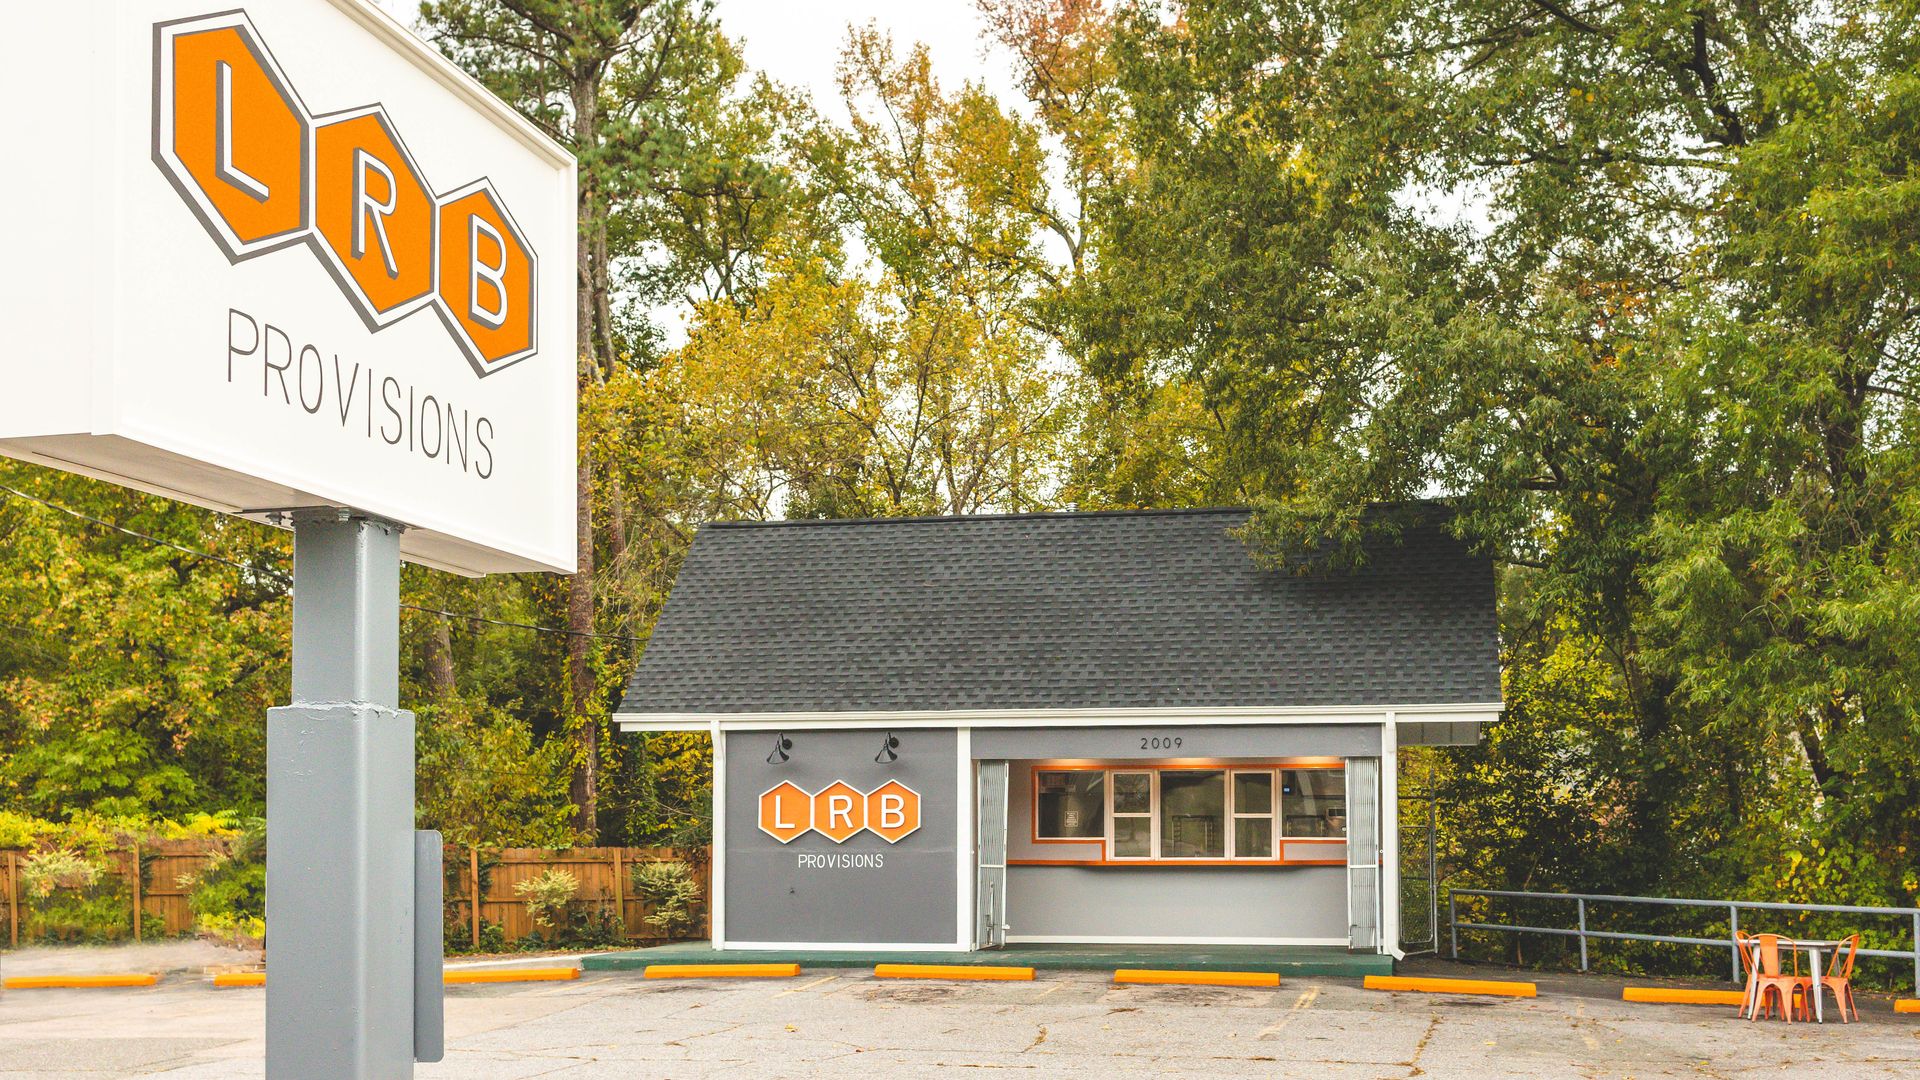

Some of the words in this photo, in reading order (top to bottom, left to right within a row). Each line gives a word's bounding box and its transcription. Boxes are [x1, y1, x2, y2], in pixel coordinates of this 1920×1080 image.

[215, 60, 509, 330] LRB
[227, 307, 494, 480] PROVISIONS
[1140, 737, 1183, 750] 2009
[775, 794, 906, 829] LRB
[798, 853, 884, 868] PROVISIONS
